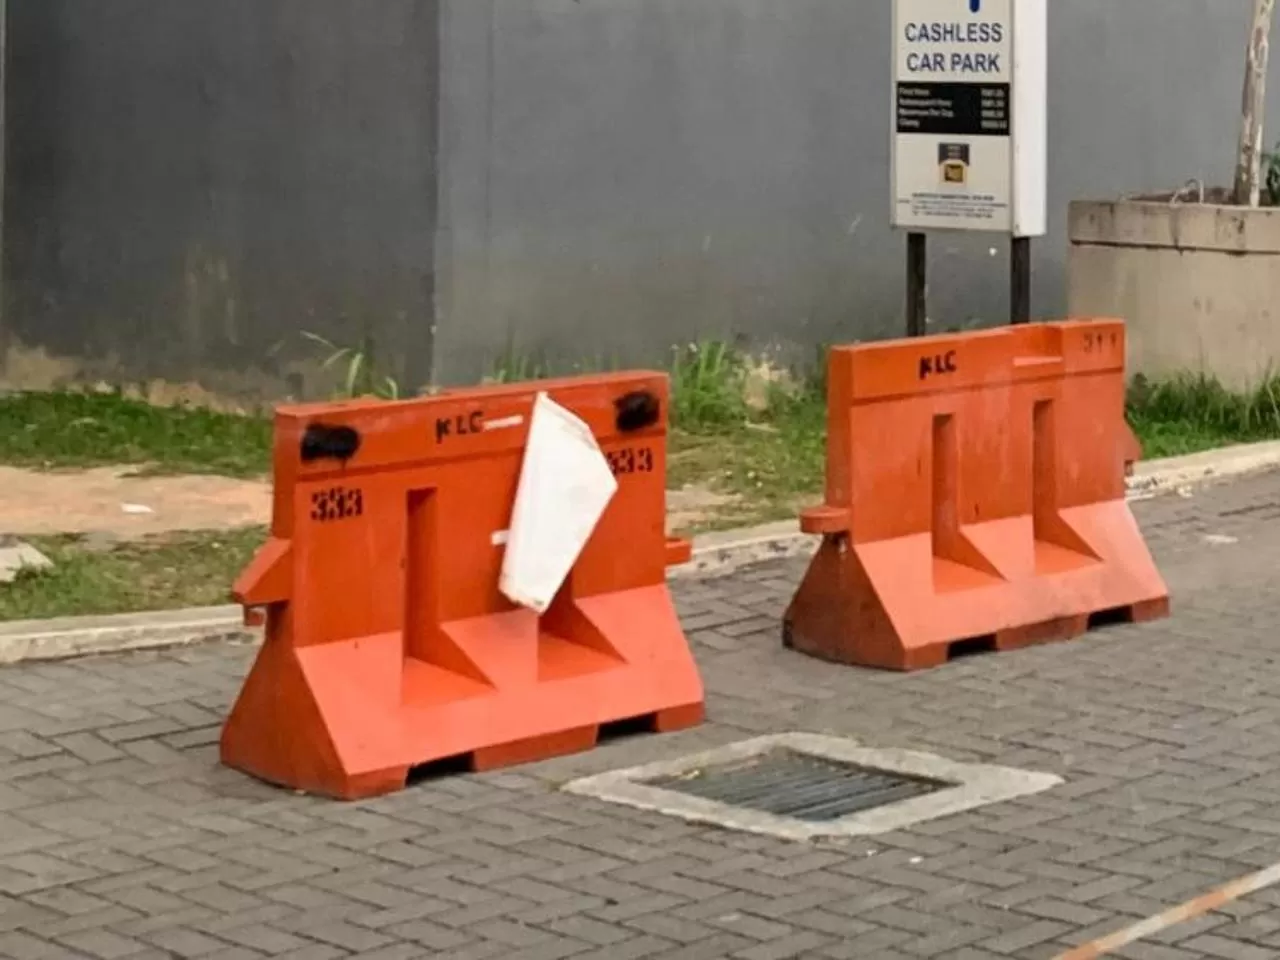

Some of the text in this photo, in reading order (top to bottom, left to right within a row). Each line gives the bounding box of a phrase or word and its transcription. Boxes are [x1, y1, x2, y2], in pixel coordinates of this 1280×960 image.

[904, 22, 1003, 43] CASHLESS
[906, 53, 1001, 73] CAR PARK
[919, 350, 956, 380] KLC
[435, 411, 484, 444] KLC
